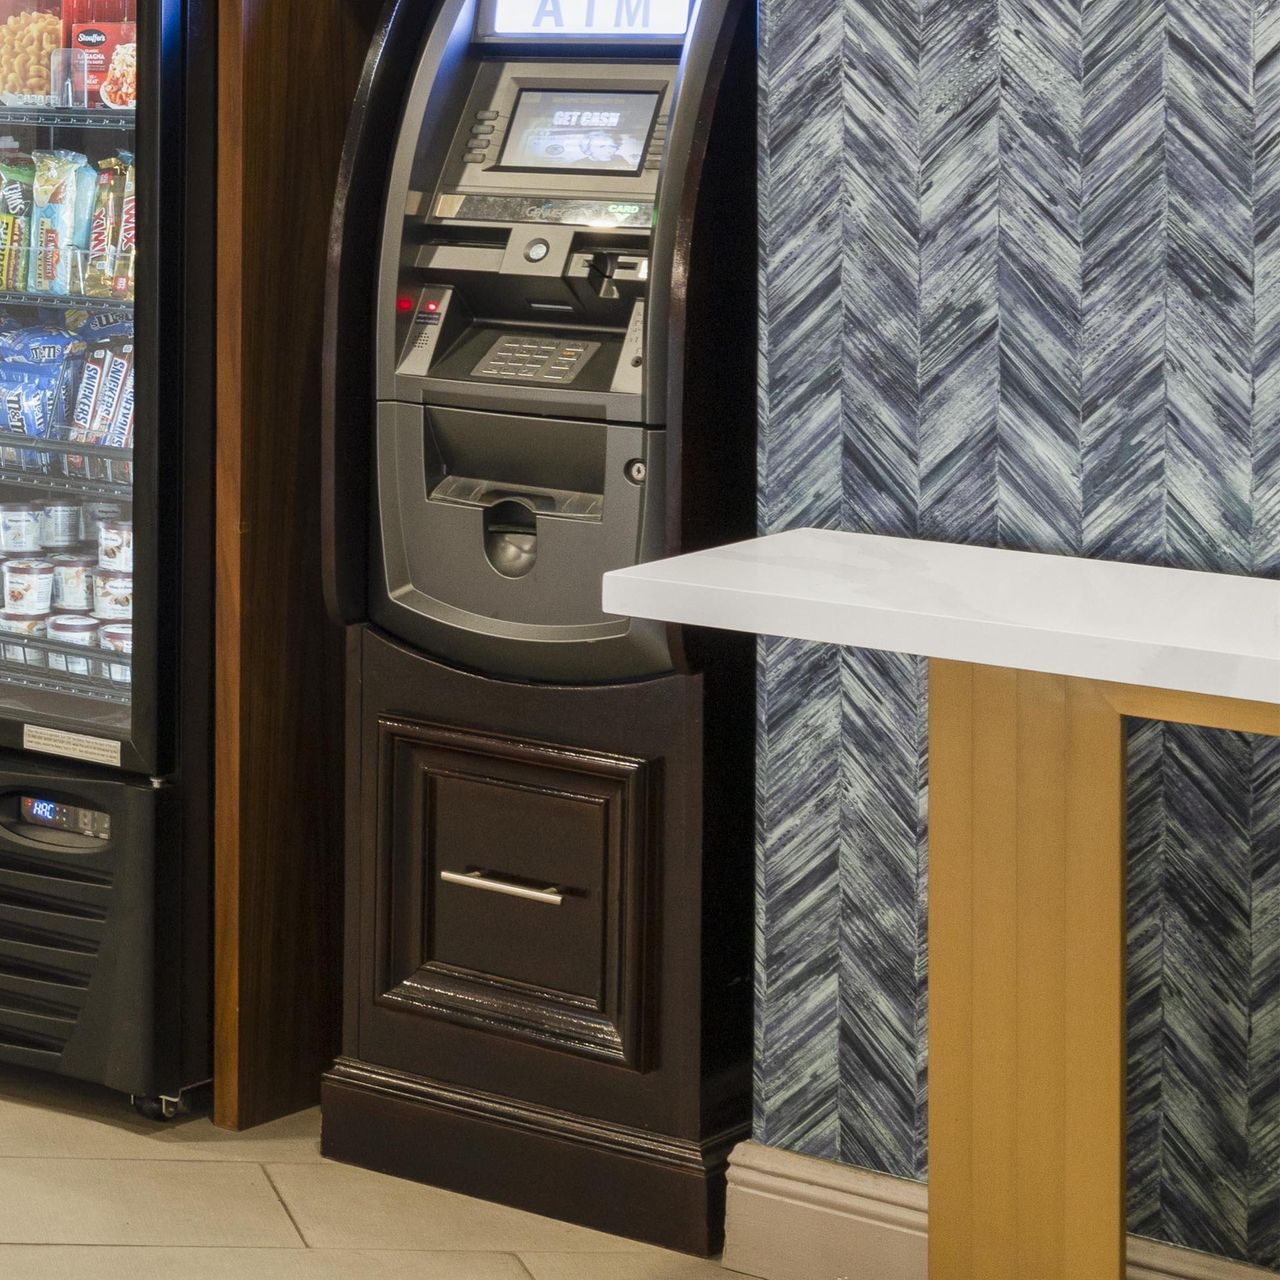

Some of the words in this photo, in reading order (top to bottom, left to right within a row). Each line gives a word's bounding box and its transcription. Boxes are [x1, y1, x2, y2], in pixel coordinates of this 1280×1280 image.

[77, 33, 106, 44] Stouffer's
[552, 111, 582, 128] GET
[582, 111, 621, 128] CASH
[608, 204, 640, 214] CARD
[75, 365, 99, 426] SNICKERS
[104, 359, 126, 418] SNICKERS
